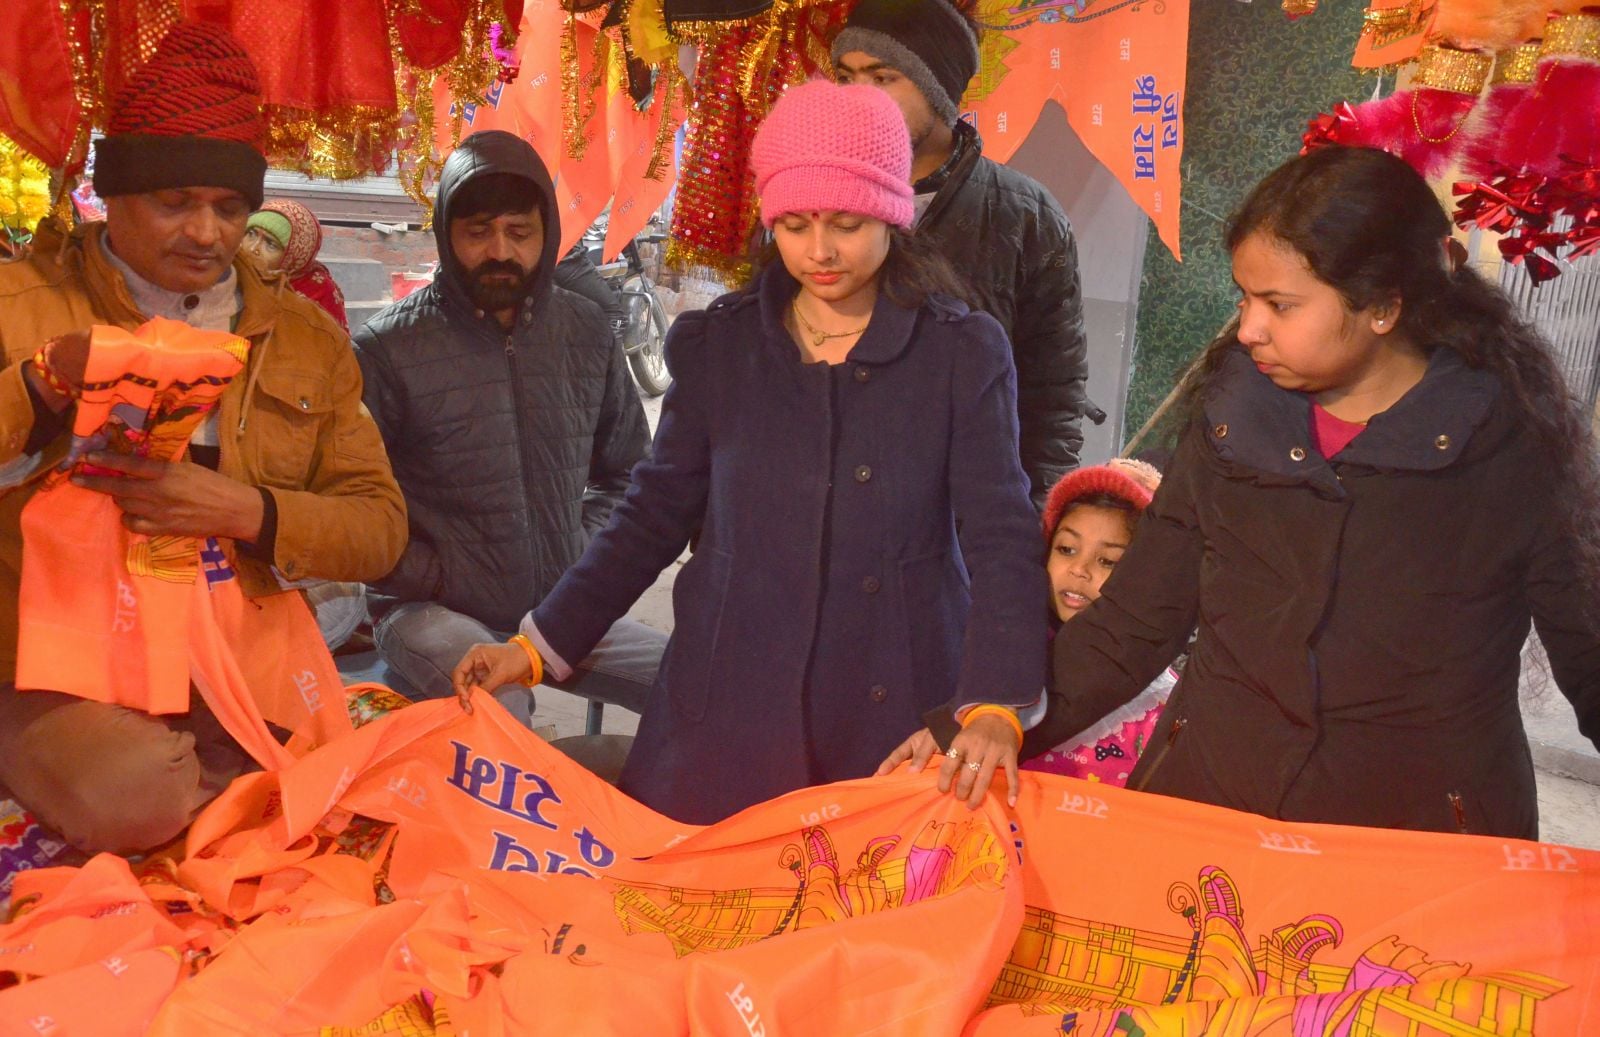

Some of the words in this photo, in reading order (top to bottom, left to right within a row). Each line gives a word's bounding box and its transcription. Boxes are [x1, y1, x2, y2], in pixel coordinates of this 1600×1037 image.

[1050, 47, 1060, 69] राम
[1120, 38, 1131, 61] राम
[1132, 75, 1162, 115] श्री
[997, 112, 1007, 133] राम
[1092, 104, 1103, 126] राम
[1162, 92, 1179, 149] जय
[1133, 124, 1156, 180] राम
[1063, 750, 1088, 765] love
[446, 740, 562, 831] राम
[1056, 790, 1108, 819] राम
[1256, 829, 1322, 855] राम
[1501, 844, 1578, 872] राम
